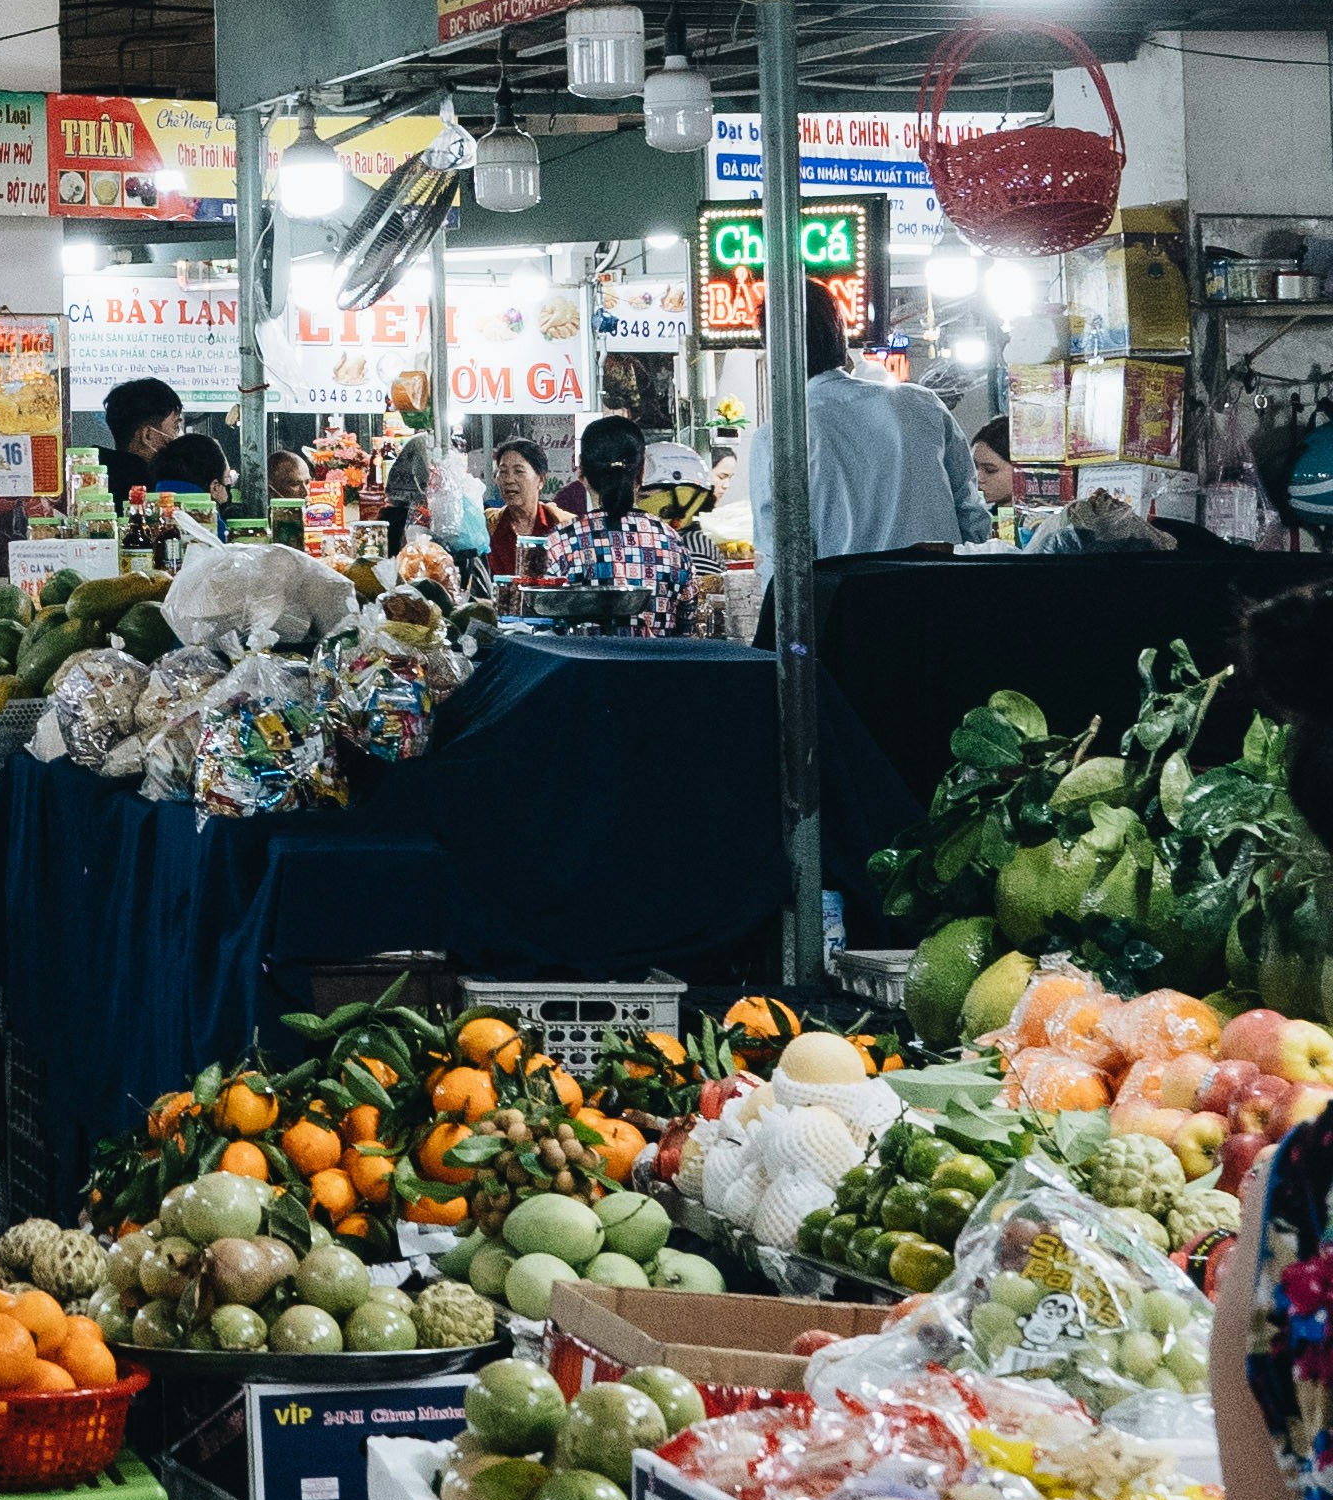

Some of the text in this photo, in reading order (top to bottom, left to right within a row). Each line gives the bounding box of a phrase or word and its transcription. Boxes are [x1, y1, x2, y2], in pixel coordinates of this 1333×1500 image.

[60, 113, 134, 158] THÂN
[355, 152, 373, 174] Rau
[801, 219, 851, 263] Cá
[107, 288, 168, 325] BẢY
[527, 354, 583, 404] GÀ
[309, 388, 348, 402] 0348
[2, 442, 23, 466] 16
[273, 1402, 313, 1426] VIP
